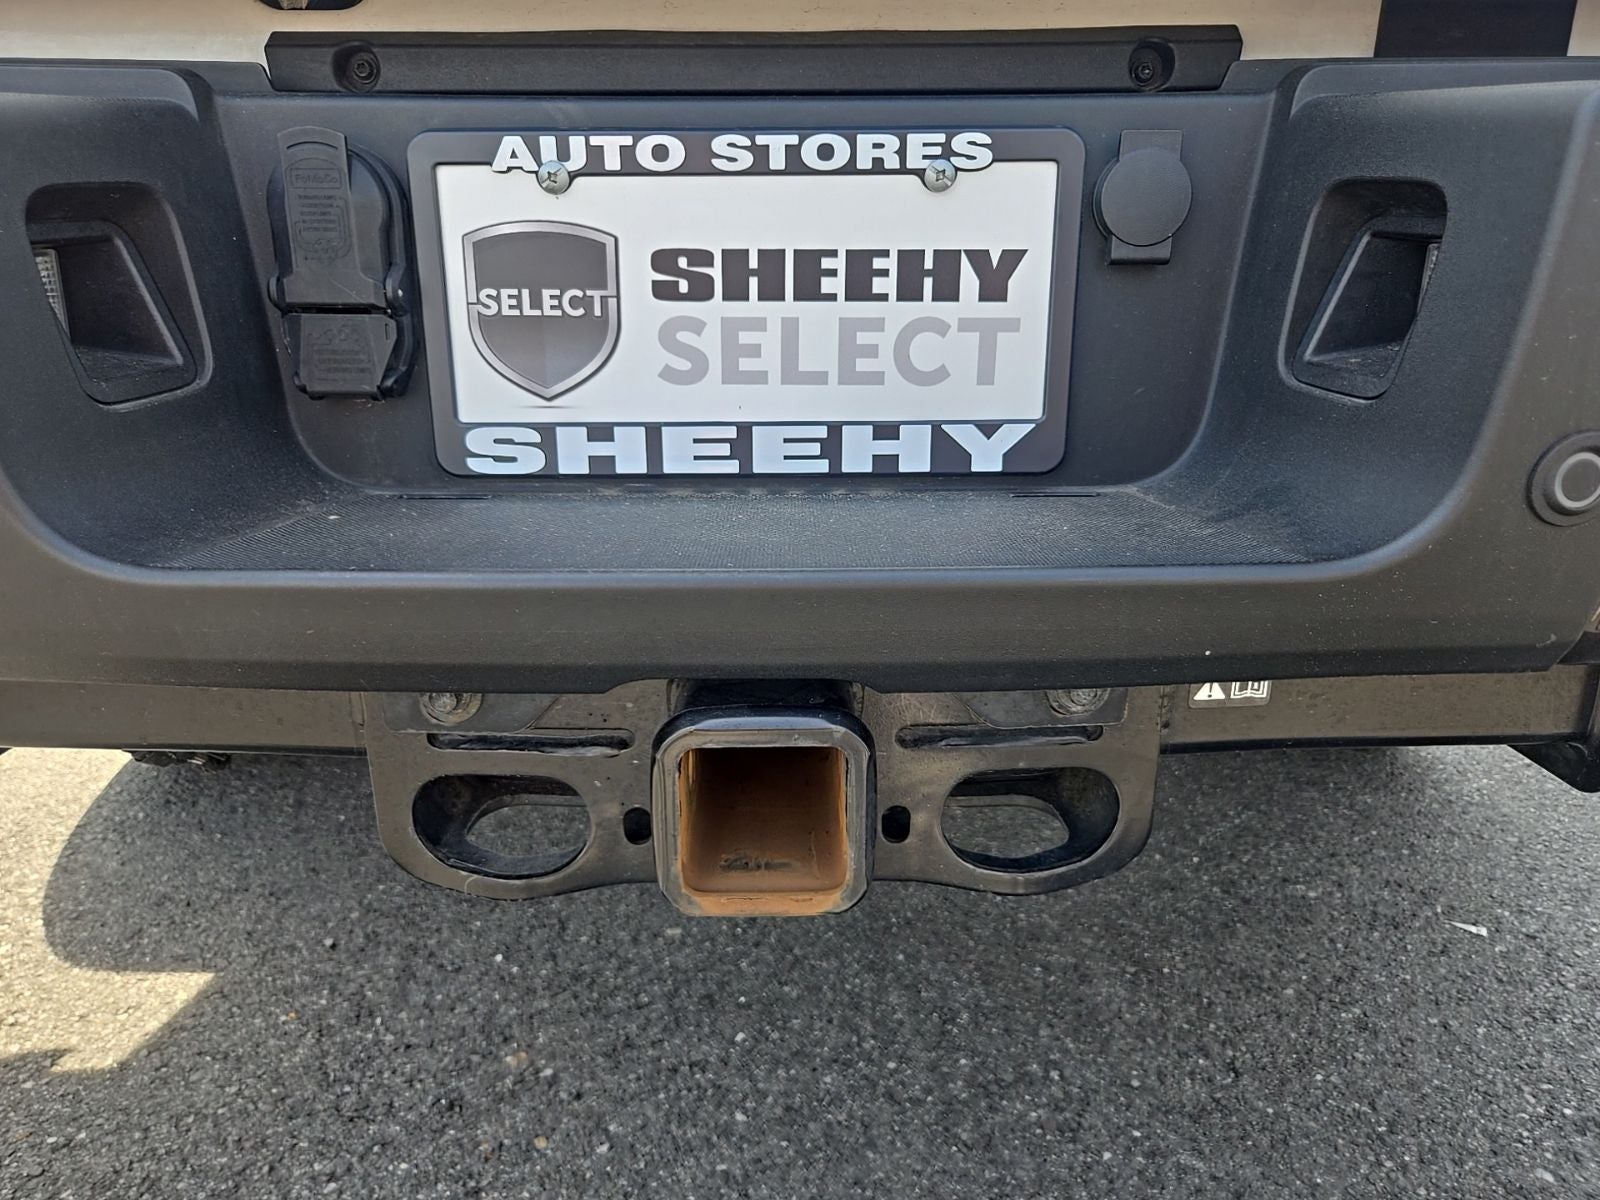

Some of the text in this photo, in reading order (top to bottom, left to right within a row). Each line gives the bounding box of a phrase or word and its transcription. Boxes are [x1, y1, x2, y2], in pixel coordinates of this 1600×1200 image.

[491, 132, 993, 173] AUTO STORES
[650, 248, 1029, 302] SHEEHY
[477, 288, 609, 317] SELECT
[657, 315, 1021, 387] SELECT
[465, 423, 1037, 475] SHEEHY
